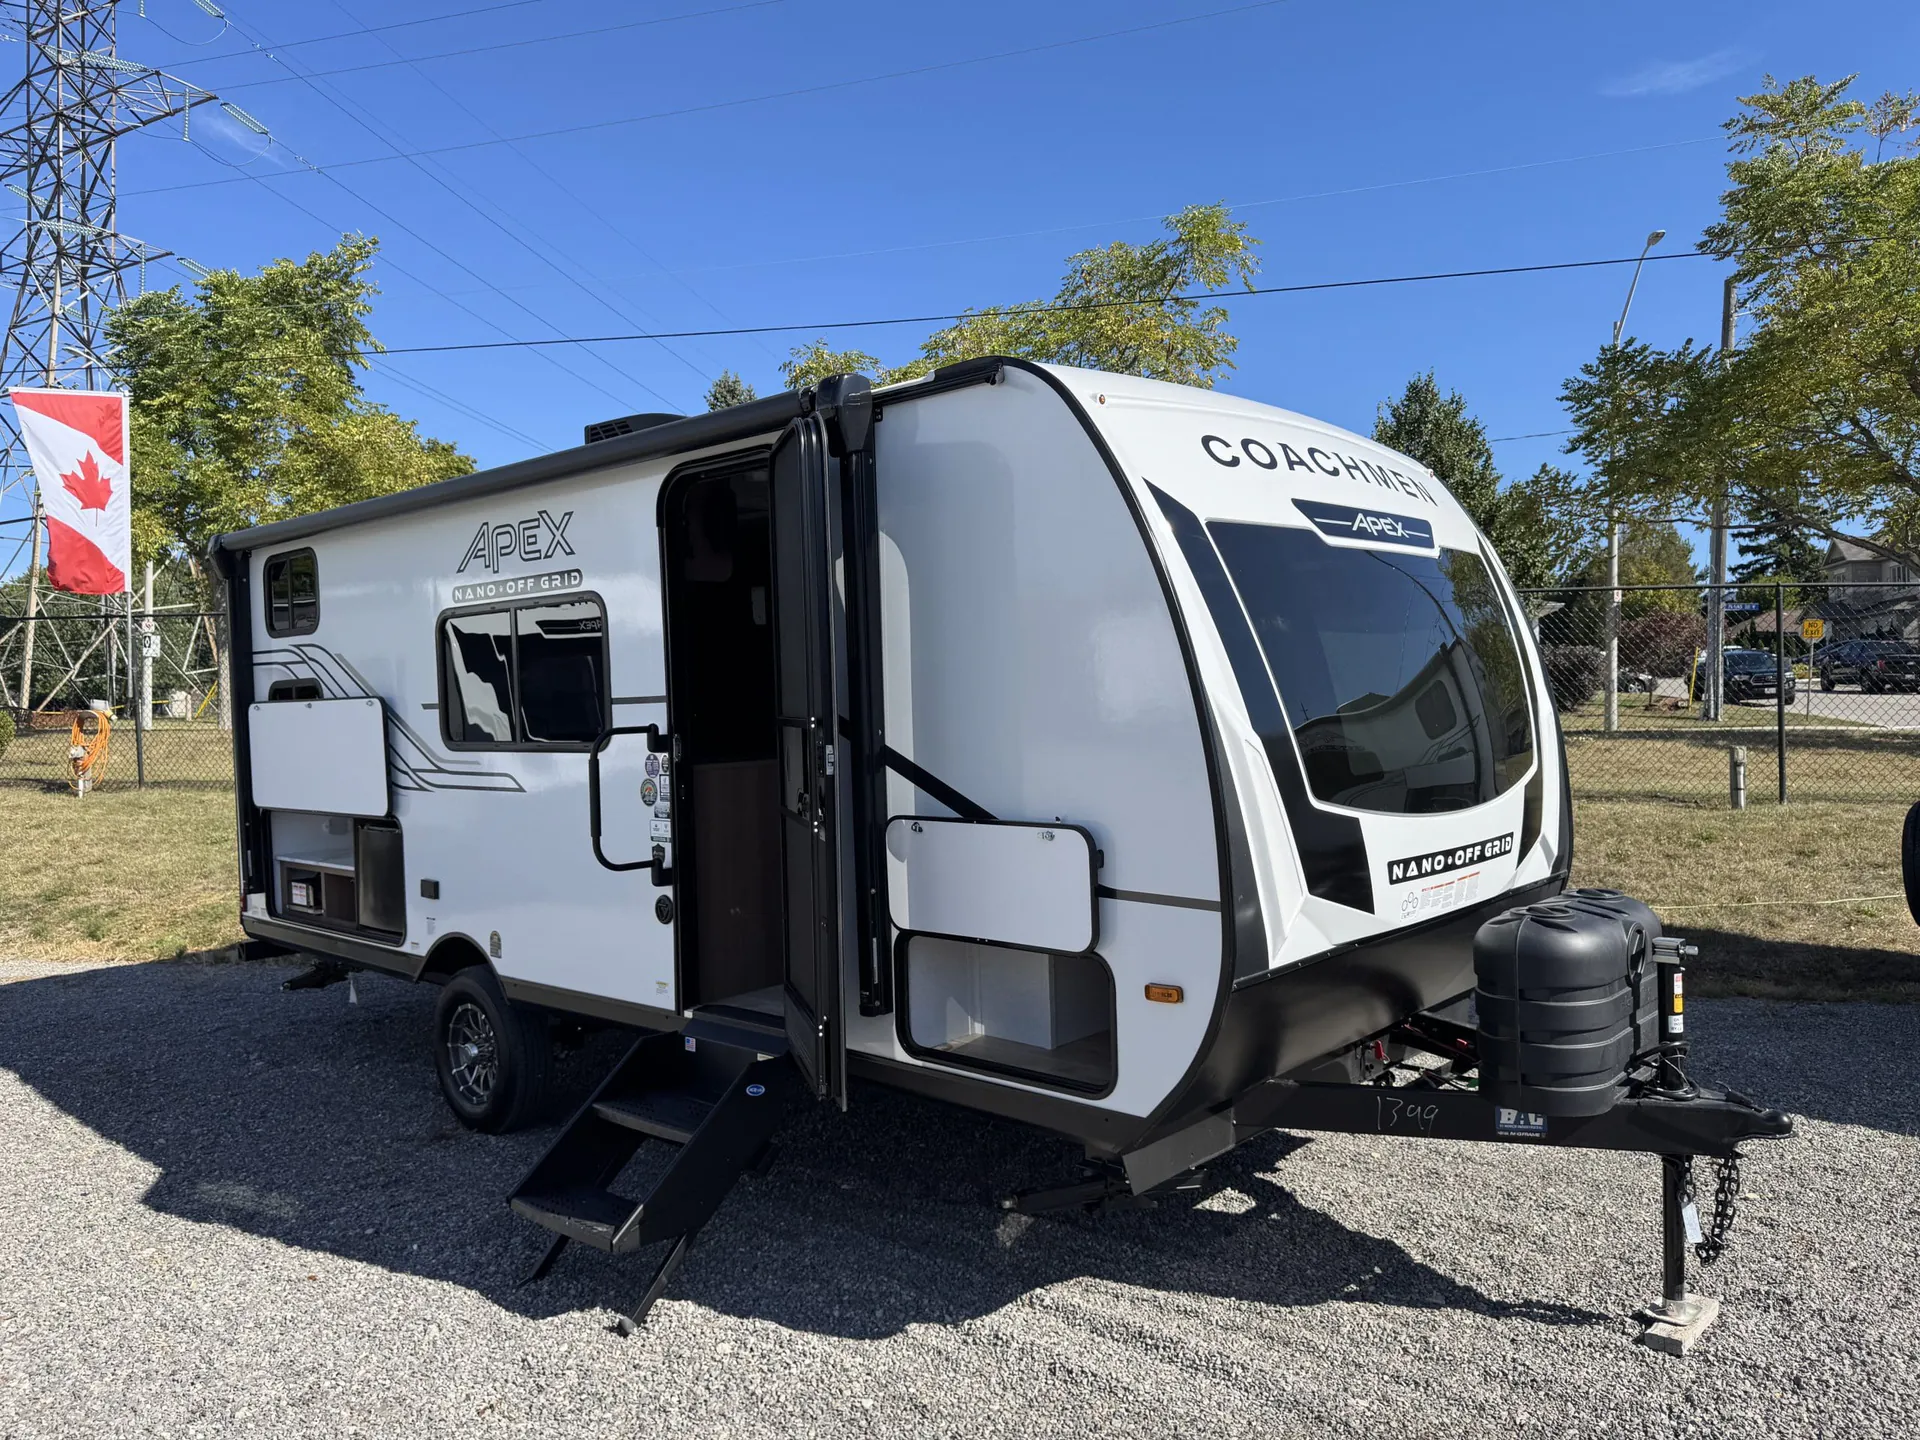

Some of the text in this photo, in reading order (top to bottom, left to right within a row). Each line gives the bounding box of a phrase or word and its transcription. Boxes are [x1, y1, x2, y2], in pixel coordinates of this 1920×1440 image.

[1200, 434, 1439, 507] COACHMEN
[456, 510, 576, 574] APEX
[1351, 512, 1410, 539] APEX
[454, 572, 580, 600] NANO OFF GRID
[1392, 836, 1512, 881] NANO OFF GRID
[1377, 1095, 1439, 1137] 1399
